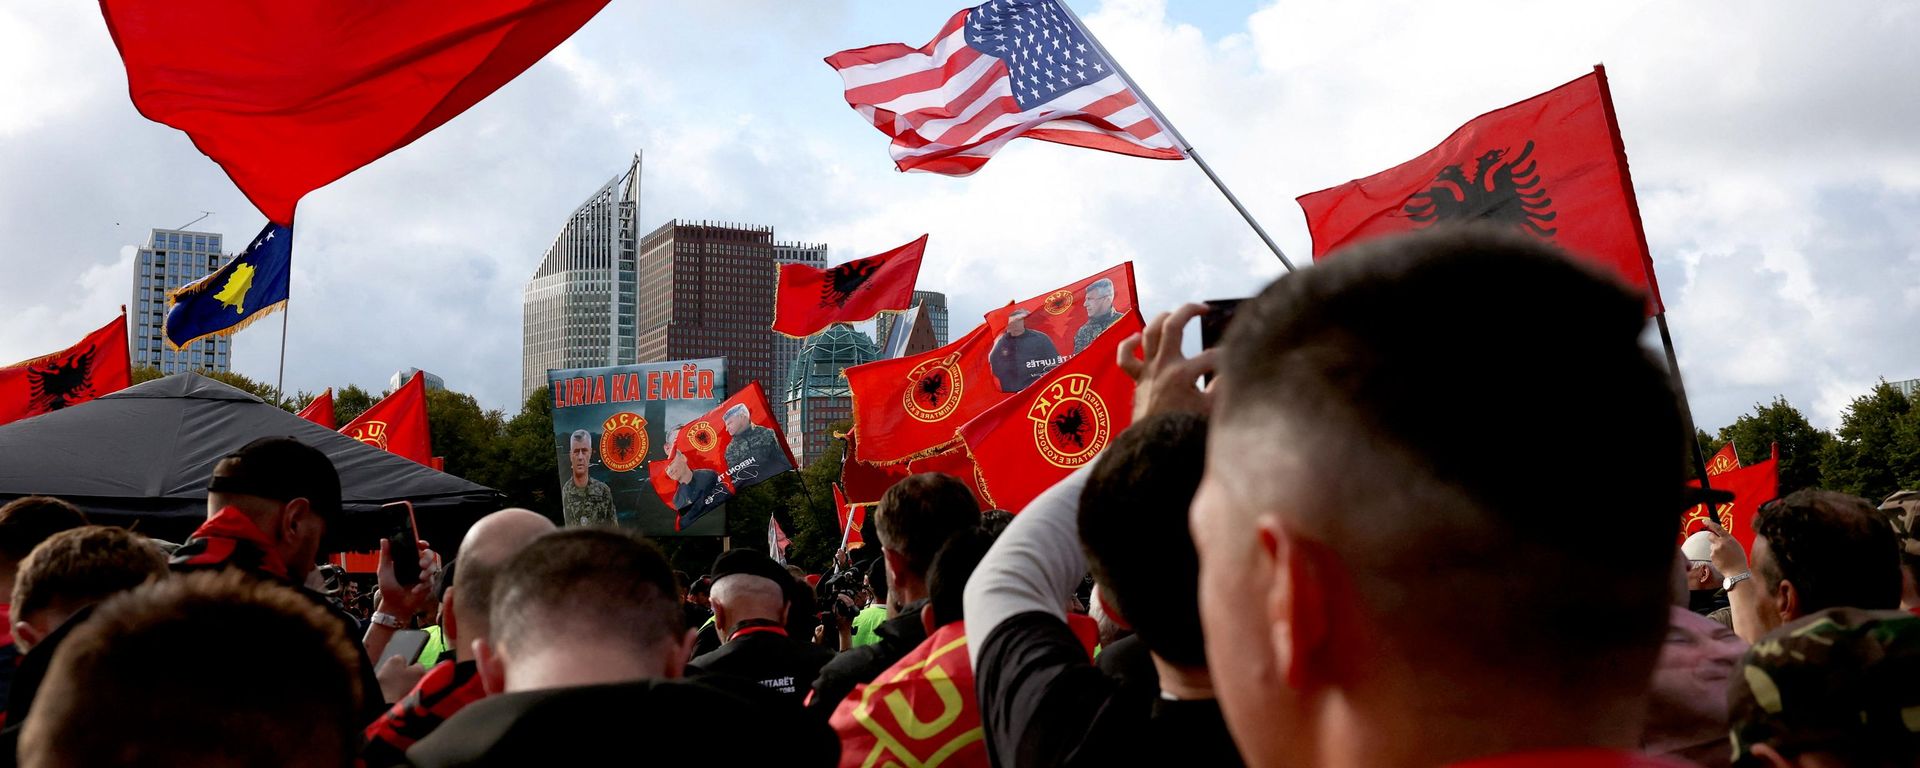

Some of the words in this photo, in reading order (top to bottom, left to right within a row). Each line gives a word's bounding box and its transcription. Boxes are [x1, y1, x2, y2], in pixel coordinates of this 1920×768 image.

[555, 375, 607, 408] LIRIA
[611, 372, 641, 403] KA
[646, 363, 715, 401] EMËR
[605, 413, 643, 431] UÇK
